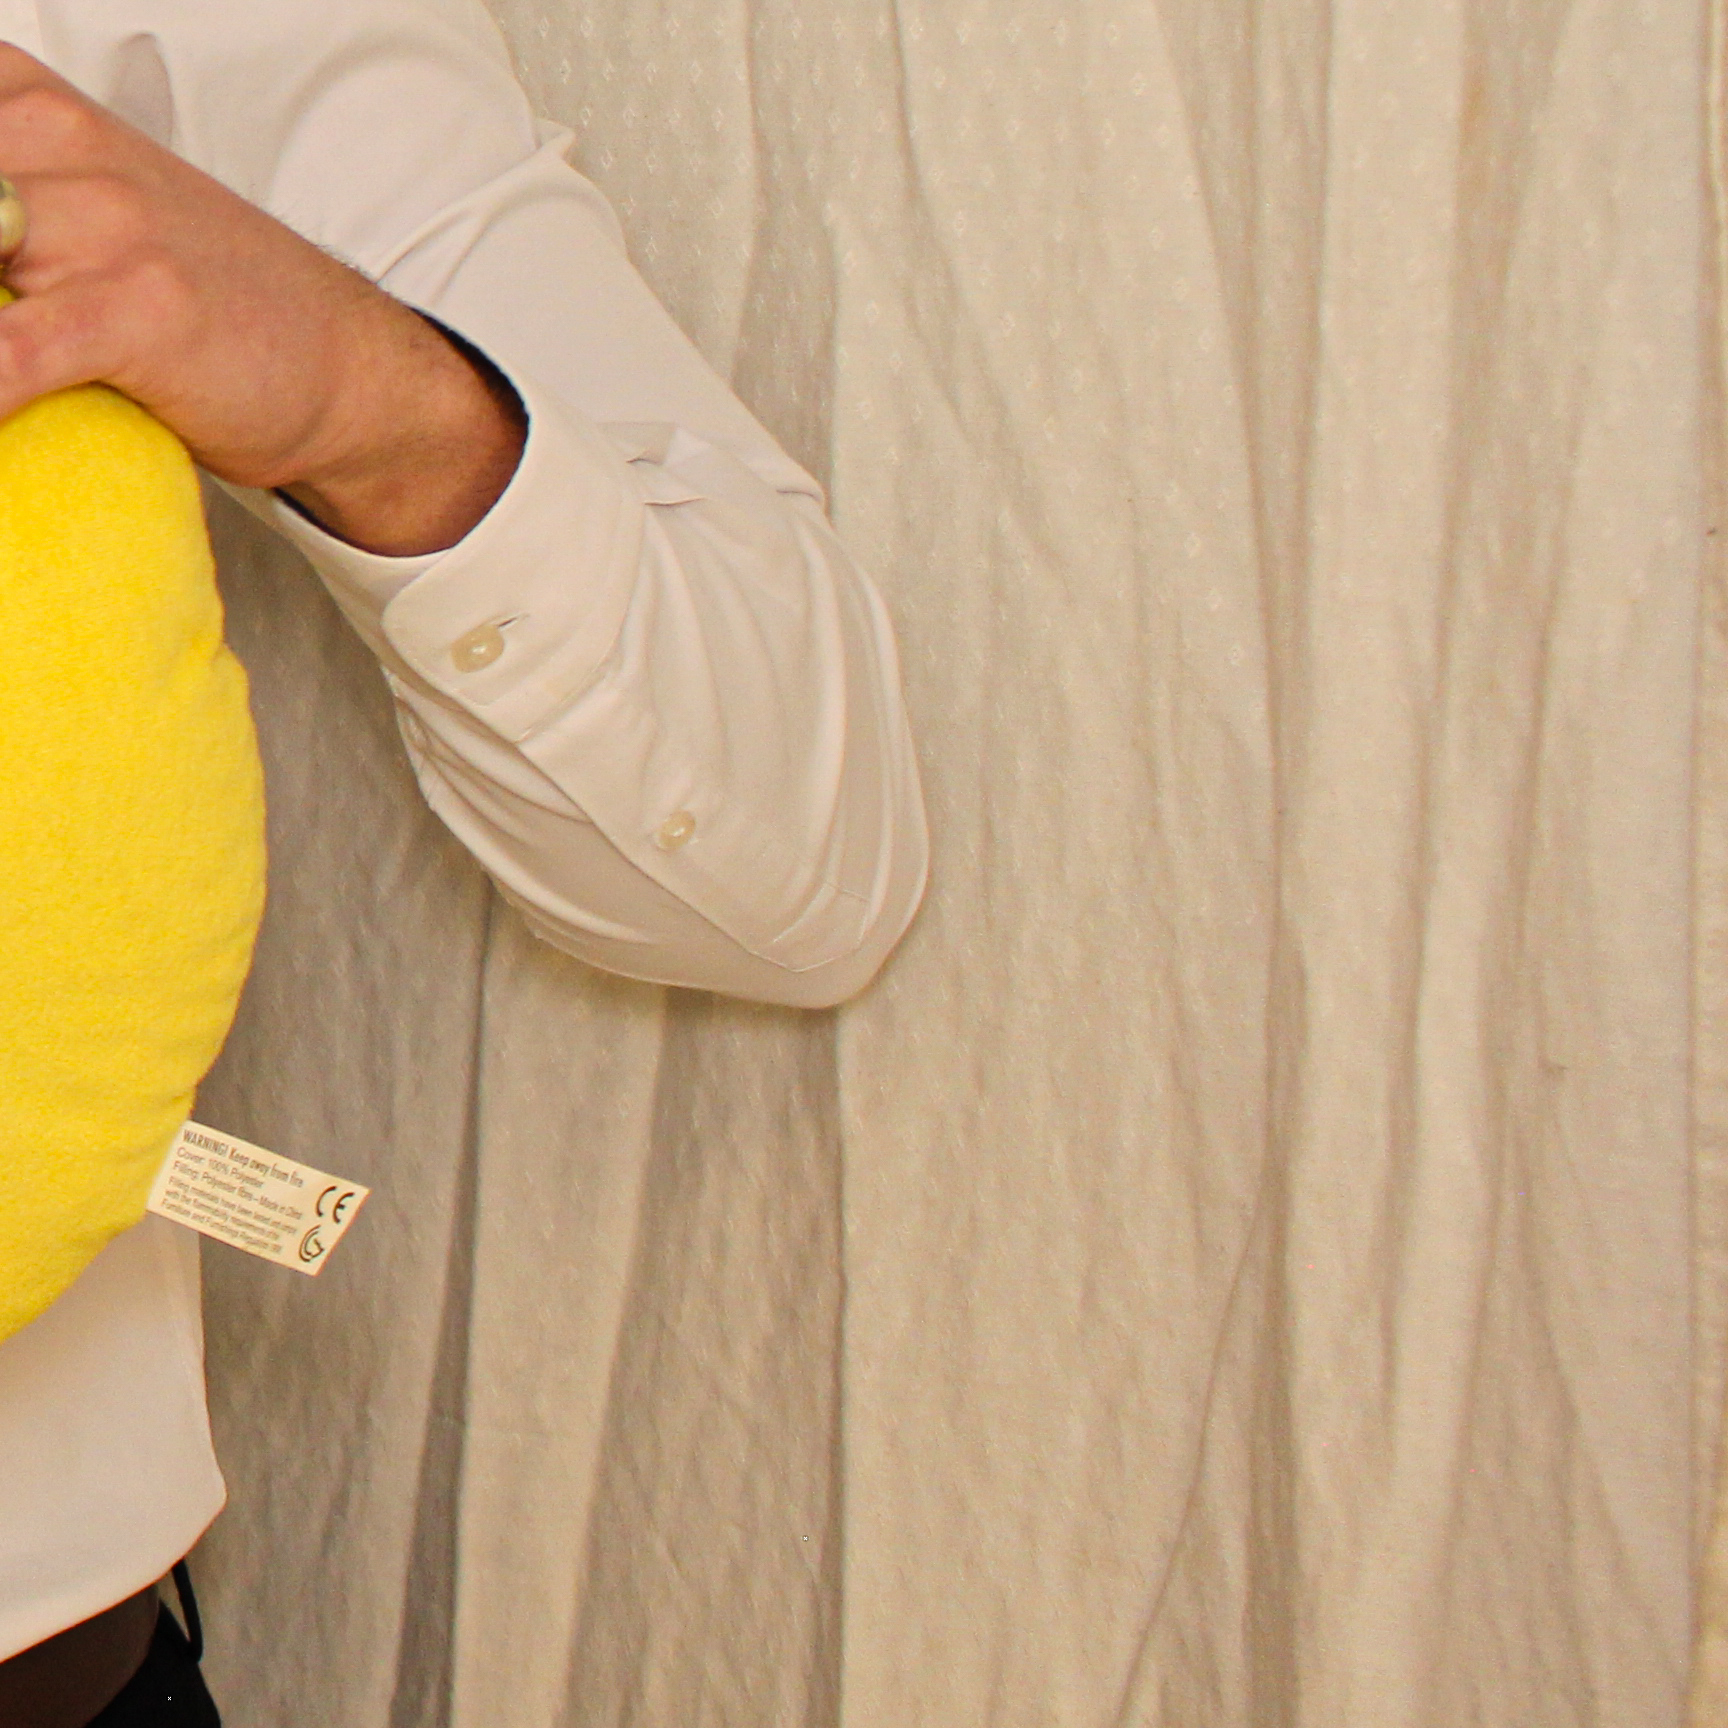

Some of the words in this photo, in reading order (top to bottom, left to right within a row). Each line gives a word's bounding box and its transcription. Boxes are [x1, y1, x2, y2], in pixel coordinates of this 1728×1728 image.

[183, 1129, 229, 1157] WARNING!
[228, 1147, 250, 1168] Keep
[249, 1159, 270, 1177] away
